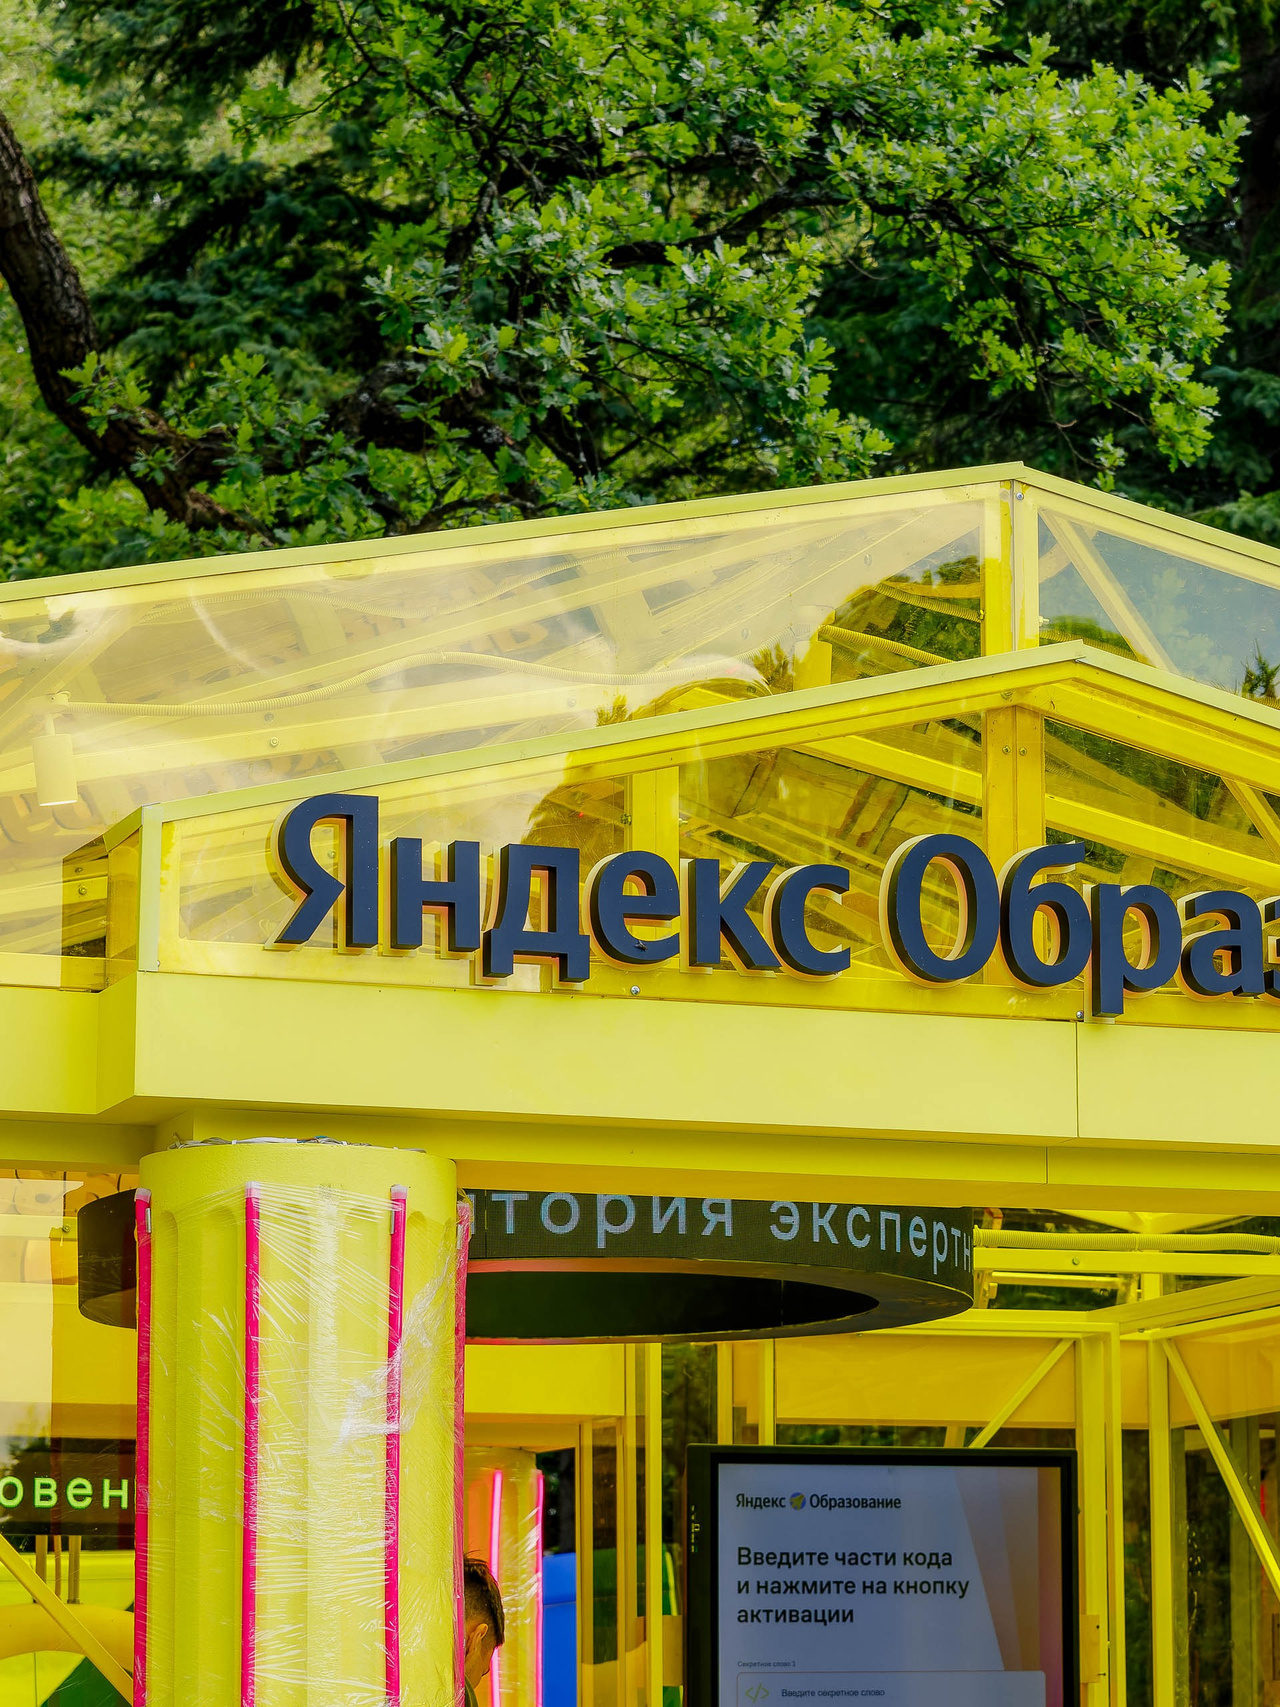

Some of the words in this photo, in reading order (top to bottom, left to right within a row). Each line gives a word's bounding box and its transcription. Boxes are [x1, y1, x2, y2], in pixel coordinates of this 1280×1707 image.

[270, 793, 852, 984] Яндекс
[769, 1201, 971, 1275] экспертн
[736, 1493, 786, 1509] Яндекс
[809, 1494, 902, 1510] Образование
[737, 1547, 829, 1569] Введите
[835, 1552, 897, 1566] части
[903, 1552, 953, 1569] кода
[737, 1580, 750, 1595] и
[756, 1580, 856, 1595] нажмите
[862, 1580, 887, 1595] на
[893, 1580, 970, 1599] кнопку
[737, 1609, 854, 1626] активации
